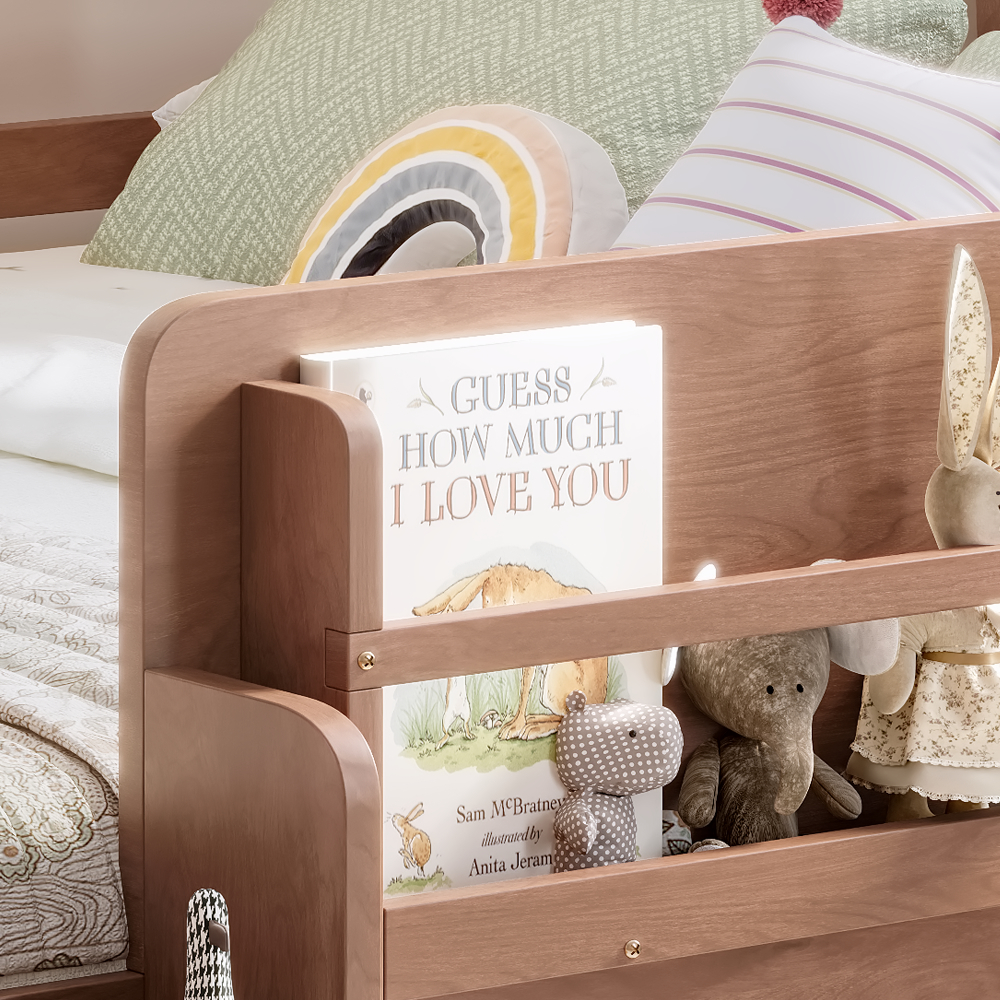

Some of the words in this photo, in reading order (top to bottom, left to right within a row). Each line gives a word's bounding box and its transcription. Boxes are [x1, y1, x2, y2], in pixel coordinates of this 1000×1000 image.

[450, 365, 572, 414] GUESS
[398, 422, 493, 472] HOW
[505, 409, 623, 457] MUCH
[390, 483, 404, 528] I
[420, 470, 533, 526] LOVE
[541, 457, 632, 510] YOU
[456, 804, 486, 824] Sam
[481, 825, 530, 847] illustrated
[530, 825, 543, 845] by
[468, 855, 507, 878] Anita
[510, 851, 553, 871] Jeram
